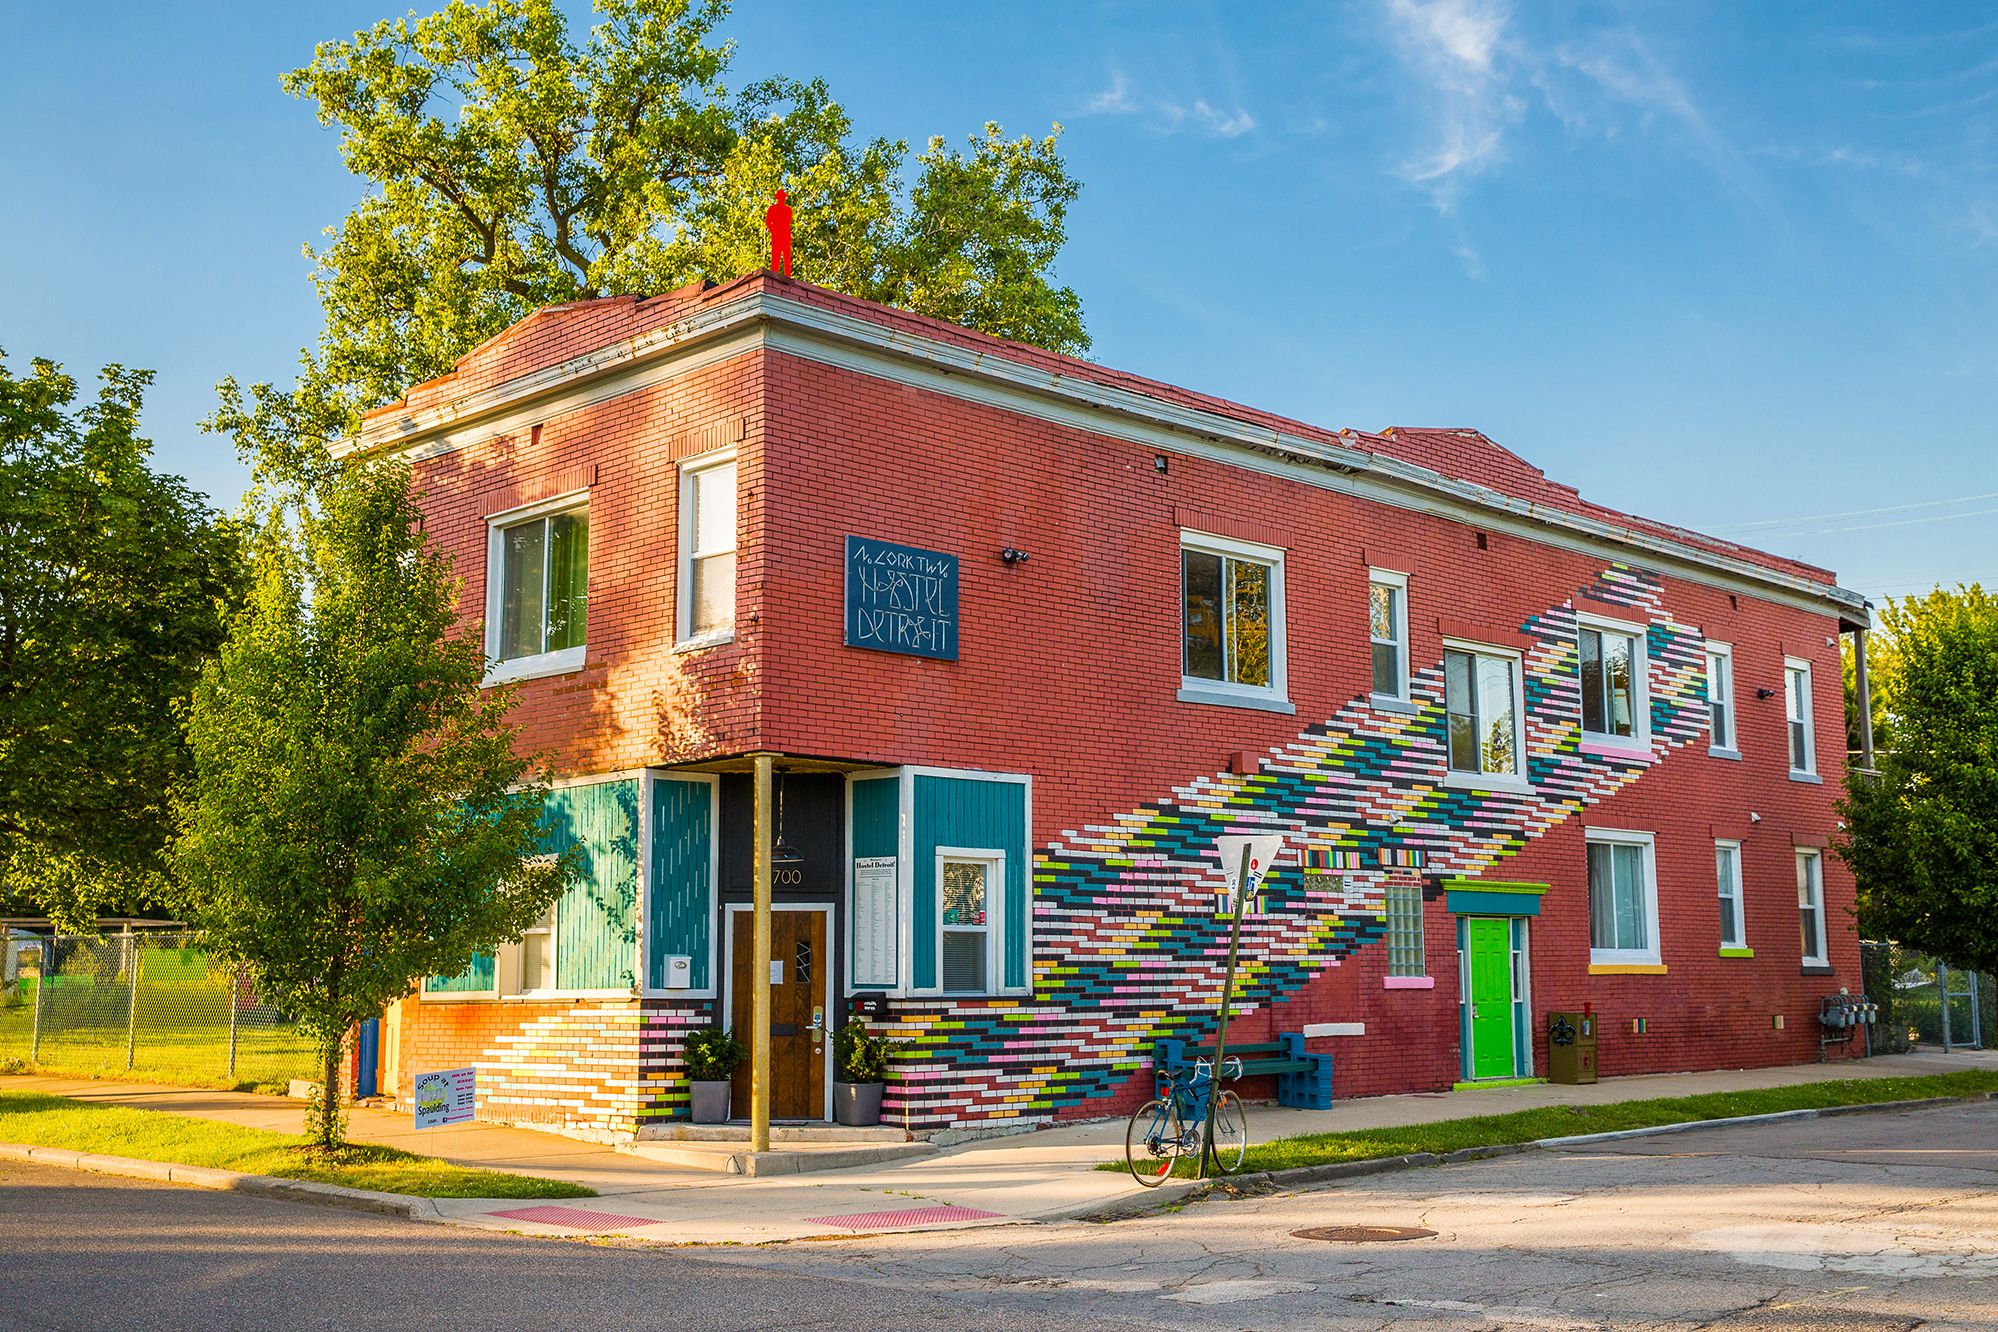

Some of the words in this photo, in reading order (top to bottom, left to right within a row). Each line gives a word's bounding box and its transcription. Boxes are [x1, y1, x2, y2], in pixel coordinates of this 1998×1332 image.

[858, 565, 950, 617] HOSTEL
[858, 607, 951, 653] DETROIT
[418, 1103, 449, 1117] Spaulding
